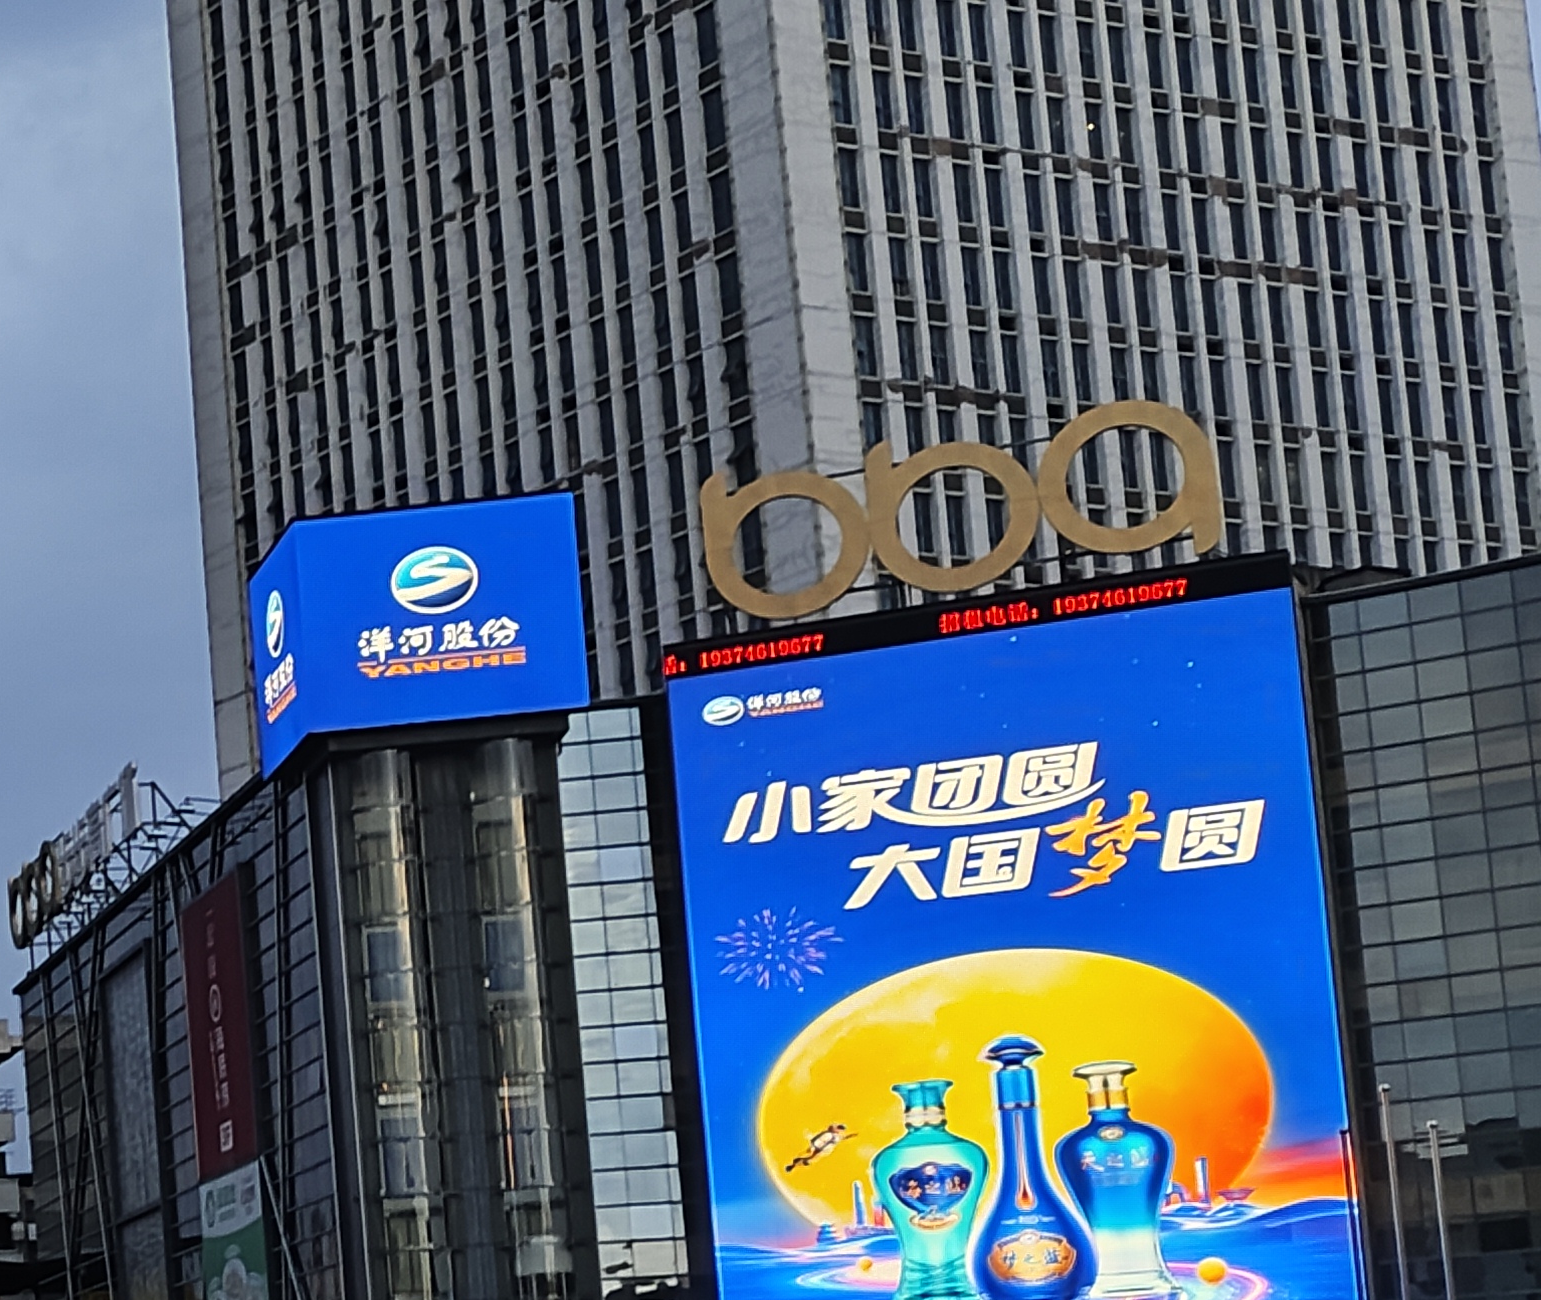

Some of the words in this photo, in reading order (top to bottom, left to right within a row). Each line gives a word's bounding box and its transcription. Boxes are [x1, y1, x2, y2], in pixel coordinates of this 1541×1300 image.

[358, 616, 520, 663] 洋河股份
[359, 651, 527, 678] YANGHE
[723, 740, 1107, 845] 小家团圆
[843, 790, 1266, 910] 大国梦圆
